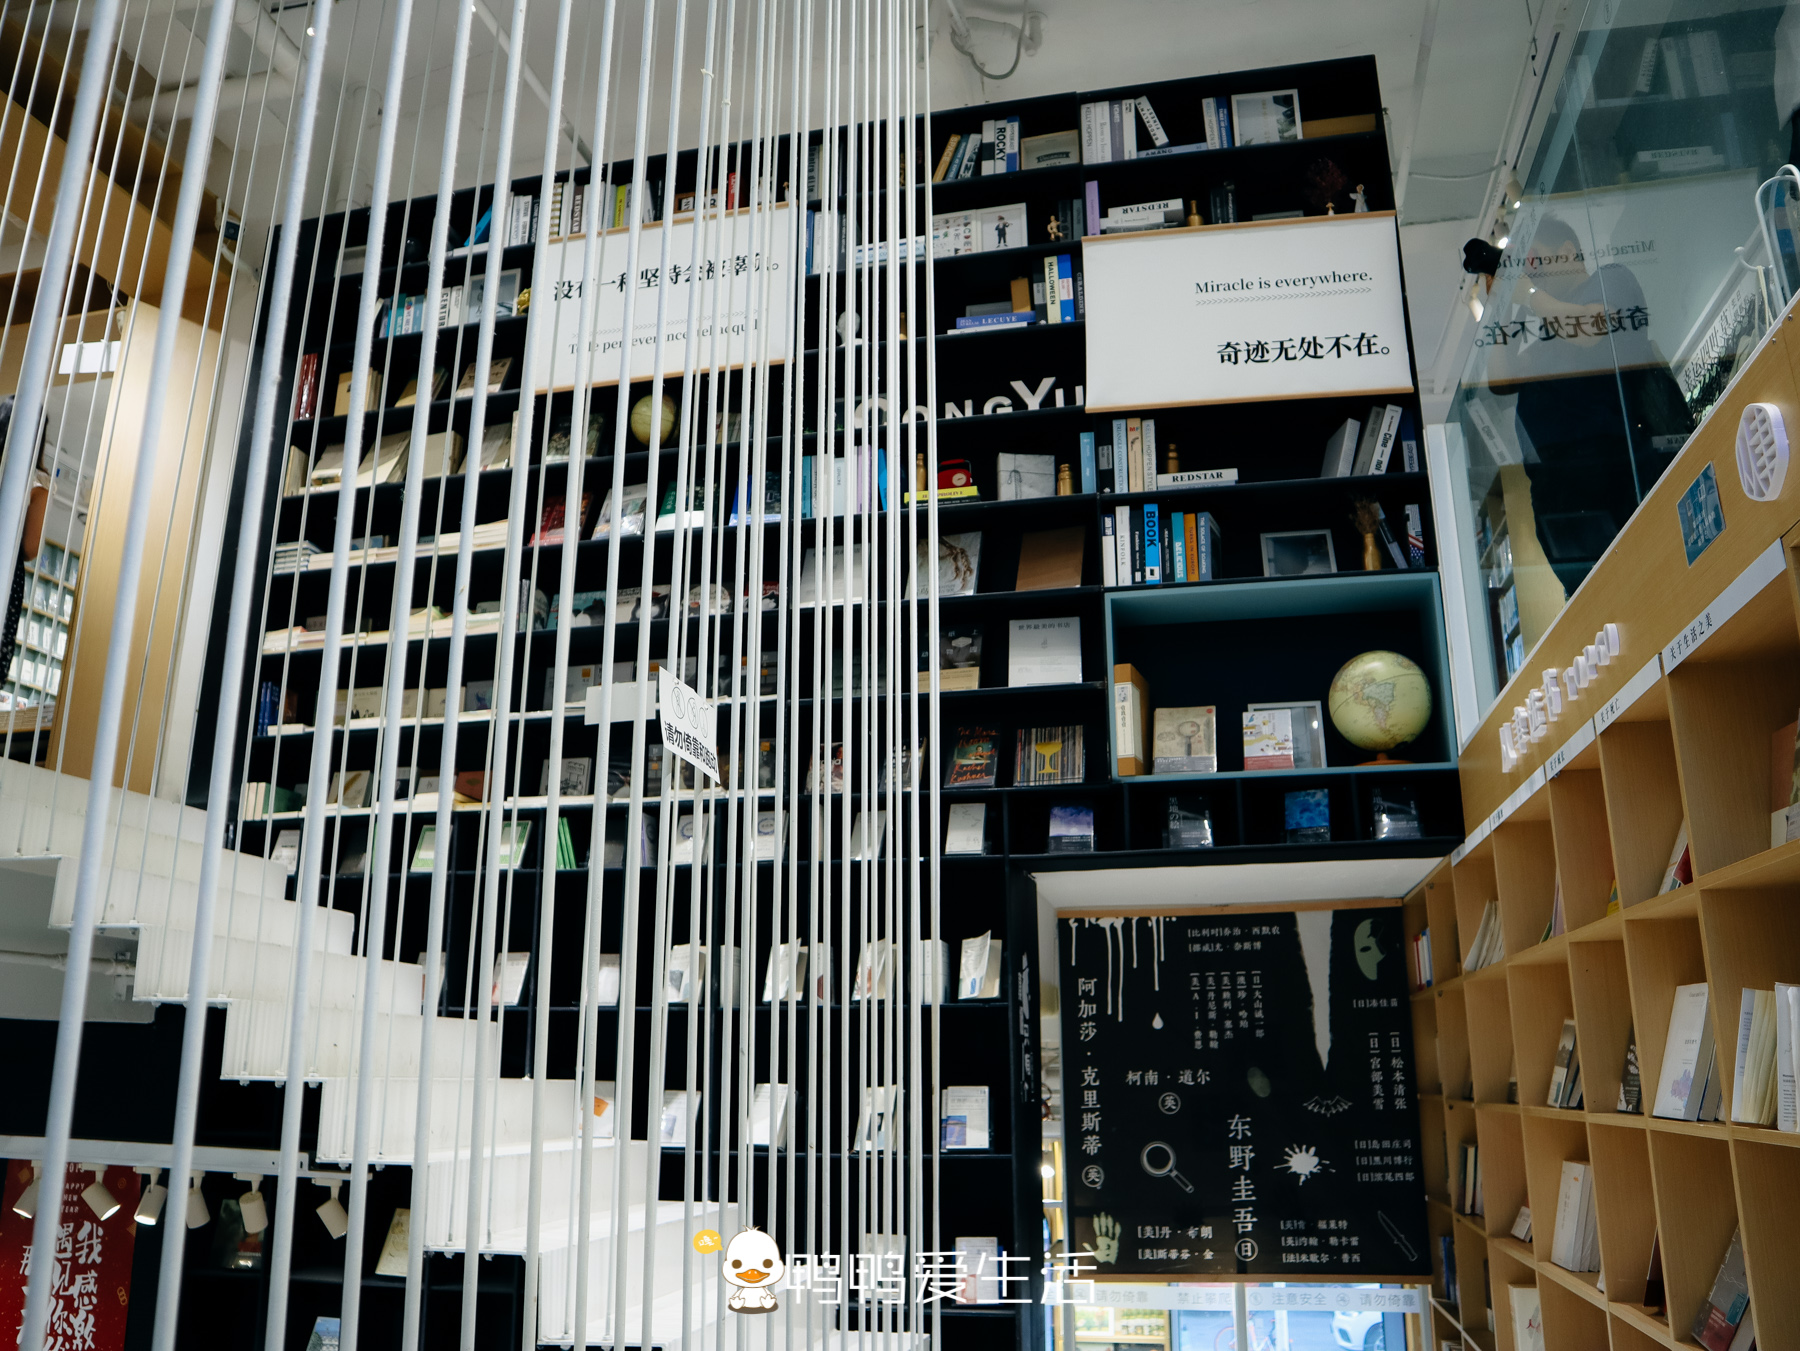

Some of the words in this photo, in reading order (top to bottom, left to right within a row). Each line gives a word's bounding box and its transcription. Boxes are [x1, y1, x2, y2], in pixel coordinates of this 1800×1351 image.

[996, 127, 1006, 162] ROCKY
[572, 195, 582, 233] REDSTAR
[1122, 201, 1170, 215] REDSTAR
[1196, 279, 1254, 294] Miracle
[1258, 277, 1272, 290] is
[1275, 269, 1373, 290] everywhere.
[1216, 332, 1390, 365] 奇迹无处不在。
[1172, 471, 1224, 483] REDSTAR
[1146, 511, 1156, 547] BOOK
[1670, 612, 1713, 661] 关于生活之美
[1077, 977, 1102, 1156] 阿加莎·克里斯蒂
[1126, 1069, 1211, 1086] 柯南·道尔
[1227, 1114, 1258, 1234] 东野圭吾
[1272, 1292, 1327, 1307] 注意安全
